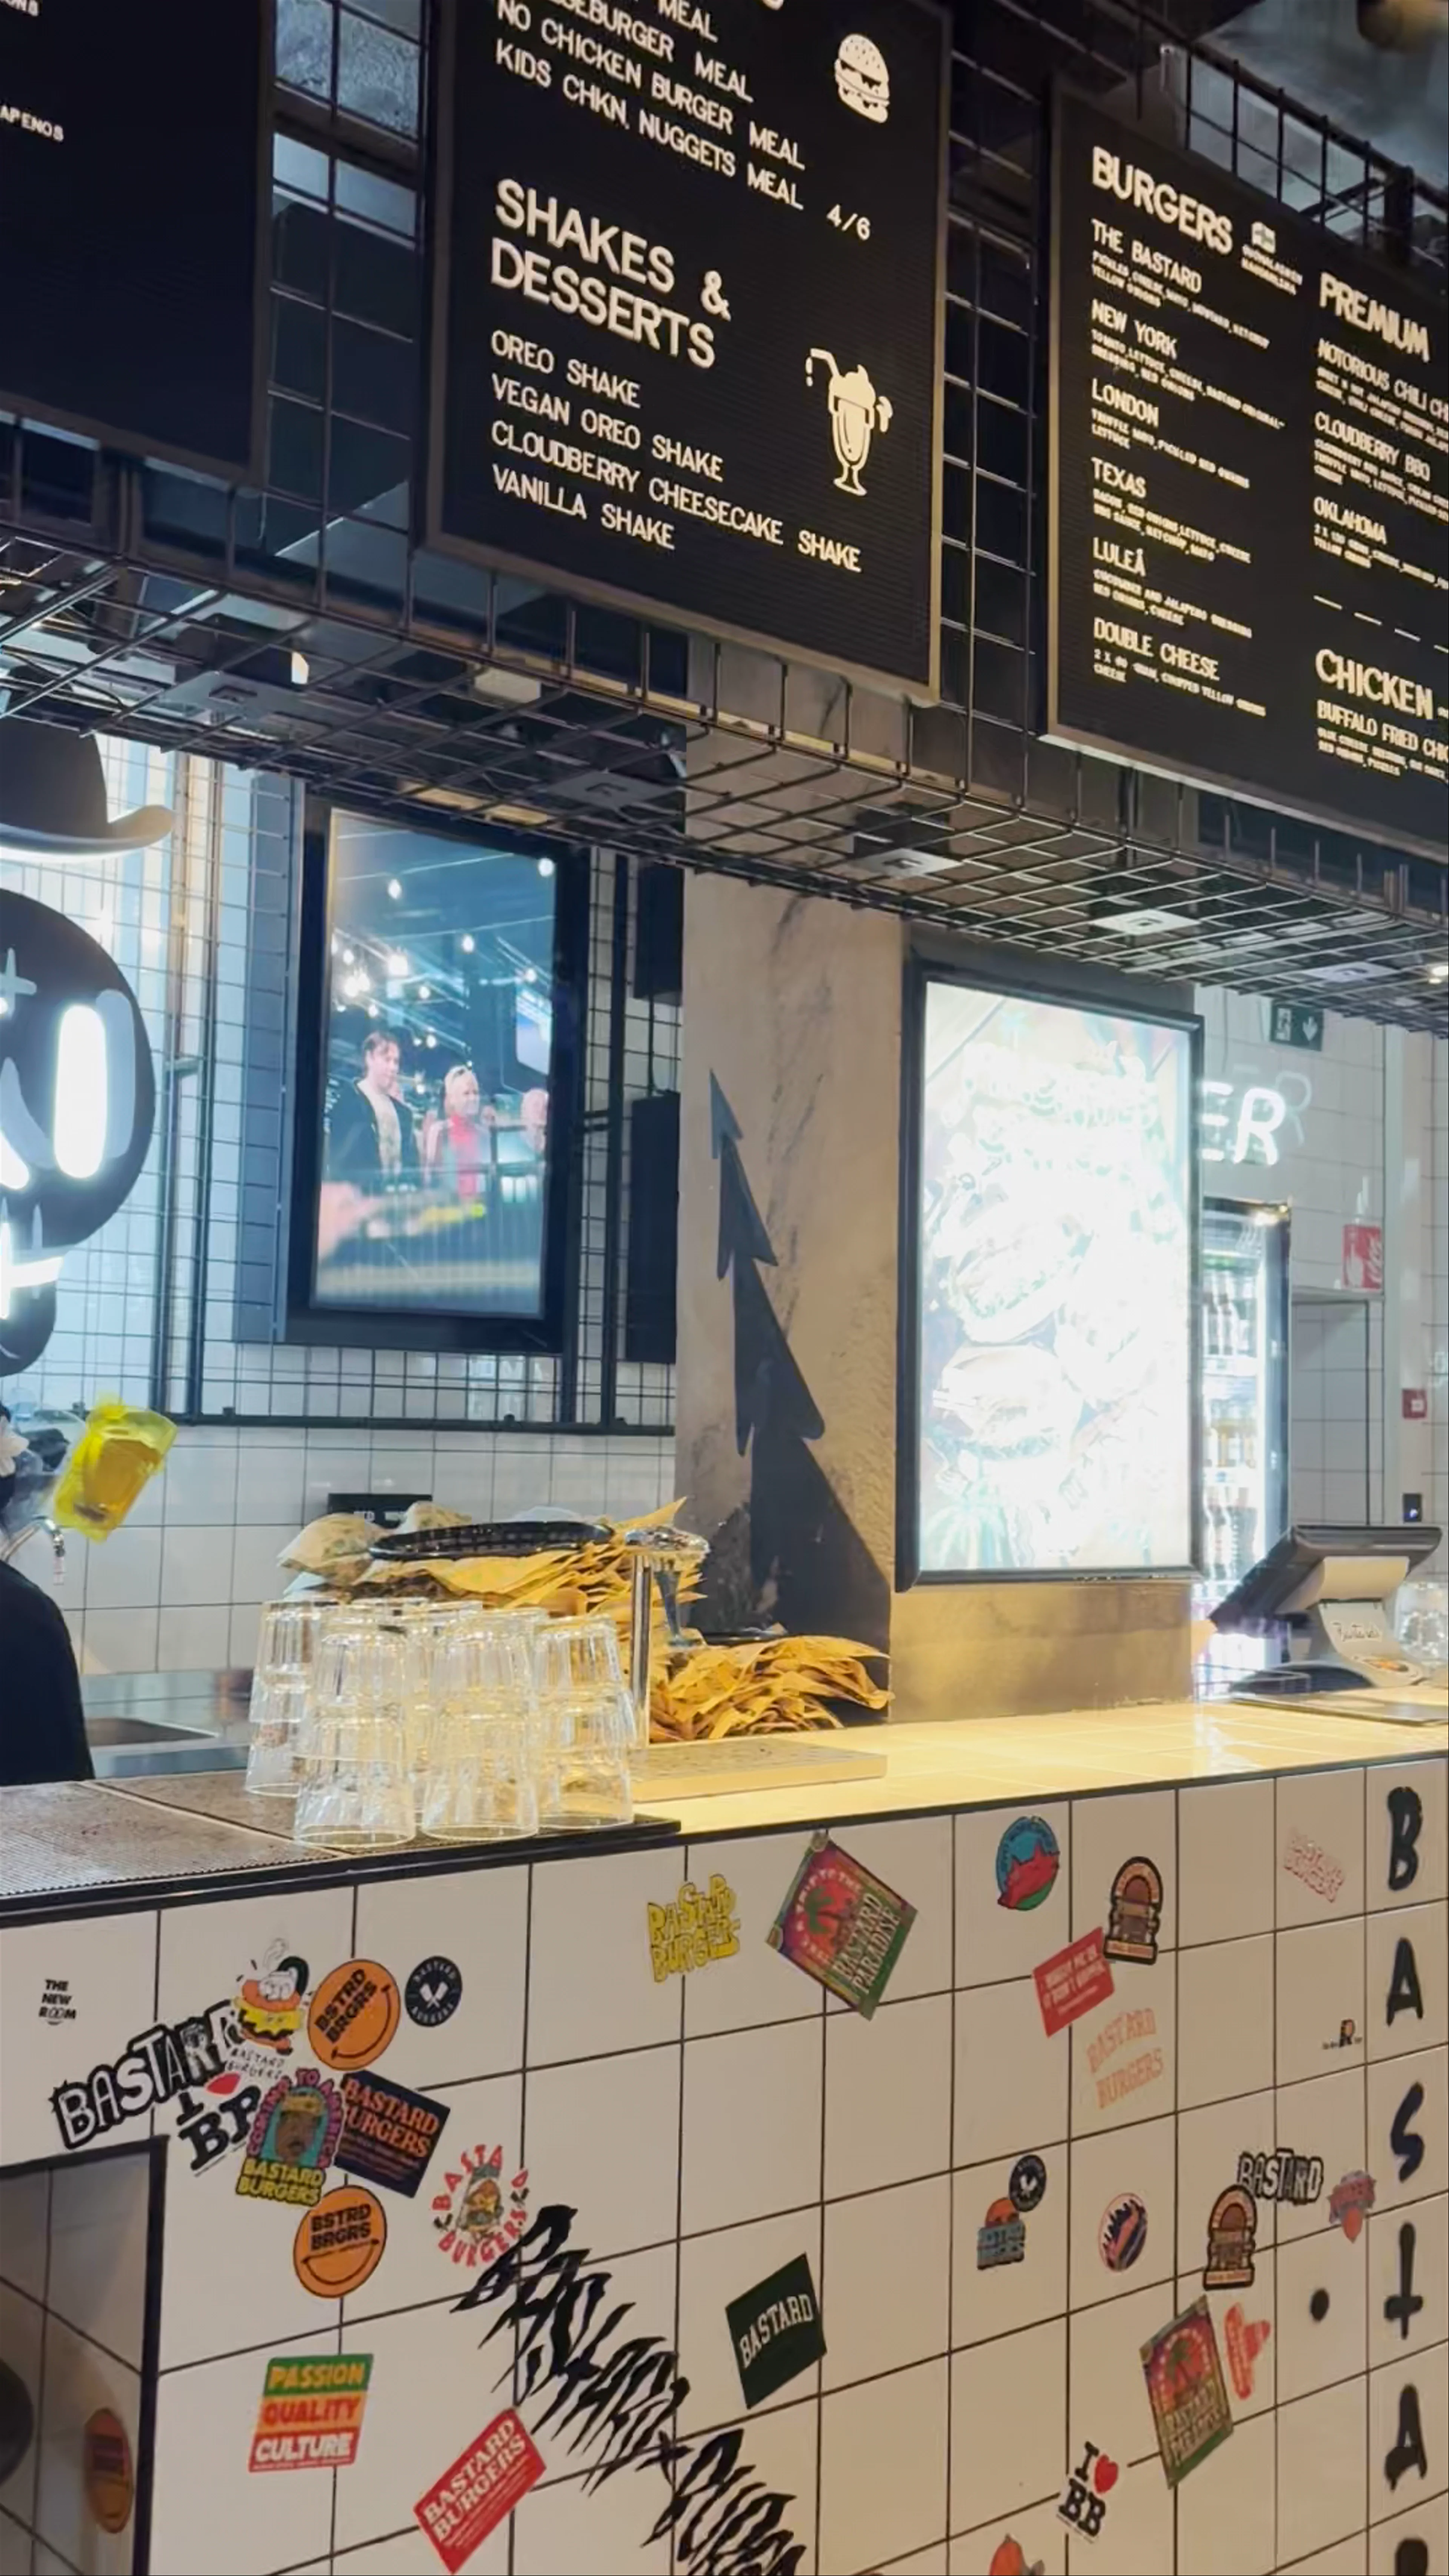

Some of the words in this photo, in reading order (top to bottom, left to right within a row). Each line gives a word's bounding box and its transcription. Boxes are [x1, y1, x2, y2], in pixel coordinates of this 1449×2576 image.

[658, 0, 717, 42] MEAL
[497, 0, 531, 31] NO
[541, 18, 641, 88] CHICKEN
[651, 72, 733, 134] BURGER
[749, 121, 804, 171] MEAL
[695, 52, 753, 102] MEAL
[497, 38, 552, 88] KIDS
[639, 109, 736, 177] NUGGETS
[747, 162, 804, 211] MEAL
[827, 204, 871, 241] 4/6
[1092, 146, 1234, 256] BURGERS
[495, 178, 675, 295] SHAKES
[700, 270, 731, 322] &
[1091, 218, 1124, 254] THE
[1132, 240, 1202, 294] BASTARD
[490, 237, 716, 368] DESSERTS
[1092, 298, 1128, 333] NEW
[1134, 320, 1178, 360] YORK
[1320, 272, 1430, 363] PREMIUM
[491, 329, 555, 374] OREO
[567, 359, 641, 409] SHAKE
[1318, 337, 1390, 392] NOTORIOUS
[1394, 379, 1427, 411] CHILI
[491, 373, 569, 426] VEGAN
[580, 409, 641, 451] OREO
[652, 435, 724, 484] SHAKE
[1092, 378, 1159, 428] LONDON
[1091, 457, 1146, 498] TEXAS
[1315, 411, 1400, 466] CLOUDBERRY
[1405, 454, 1431, 482] BBQ
[491, 419, 641, 494] CLOUDBERRY
[648, 477, 784, 546] CHEESECAKE
[797, 529, 862, 574] SHAKE
[492, 463, 587, 521] VANILLA
[601, 503, 676, 551] SHAKE
[1313, 496, 1387, 545] OKLAHOMA
[1094, 537, 1146, 577] LULEÅ
[1094, 617, 1155, 657] DOUBLE
[1160, 643, 1220, 681] CHEESE
[1315, 649, 1434, 720] CHICKEN
[1317, 699, 1378, 736] BUFFALO
[1382, 723, 1419, 751] FRIED
[832, 1893, 883, 1980] BASTARD
[852, 1906, 901, 1995] PARADISE
[38, 2007, 77, 2020] ROOM
[42, 1993, 72, 2005] NEW
[45, 1979, 69, 1992] THE
[314, 1968, 366, 2033] BSTRD
[326, 1980, 378, 2044] BRGRS
[1087, 2007, 1157, 2074] BASTARD
[296, 2067, 321, 2087] TO
[341, 2078, 440, 2136] BASTARD
[1095, 2047, 1164, 2110] BURGERS
[344, 2106, 432, 2158] URGERS
[237, 2176, 321, 2207] BURGERS
[242, 2156, 325, 2187] BASTARD
[1237, 2147, 1324, 2206] BASTARD
[310, 2222, 371, 2251] BRGRS
[311, 2204, 371, 2233] BSTRD
[738, 2293, 814, 2370] BASTARD
[268, 2363, 366, 2390] PASSION
[262, 2396, 360, 2426] QUALITY
[255, 2432, 353, 2463] CULTURE
[422, 2419, 516, 2525] BASTARD
[1075, 2441, 1100, 2482] I
[432, 2435, 526, 2542] BURGERS
[1058, 2478, 1106, 2537] BB
